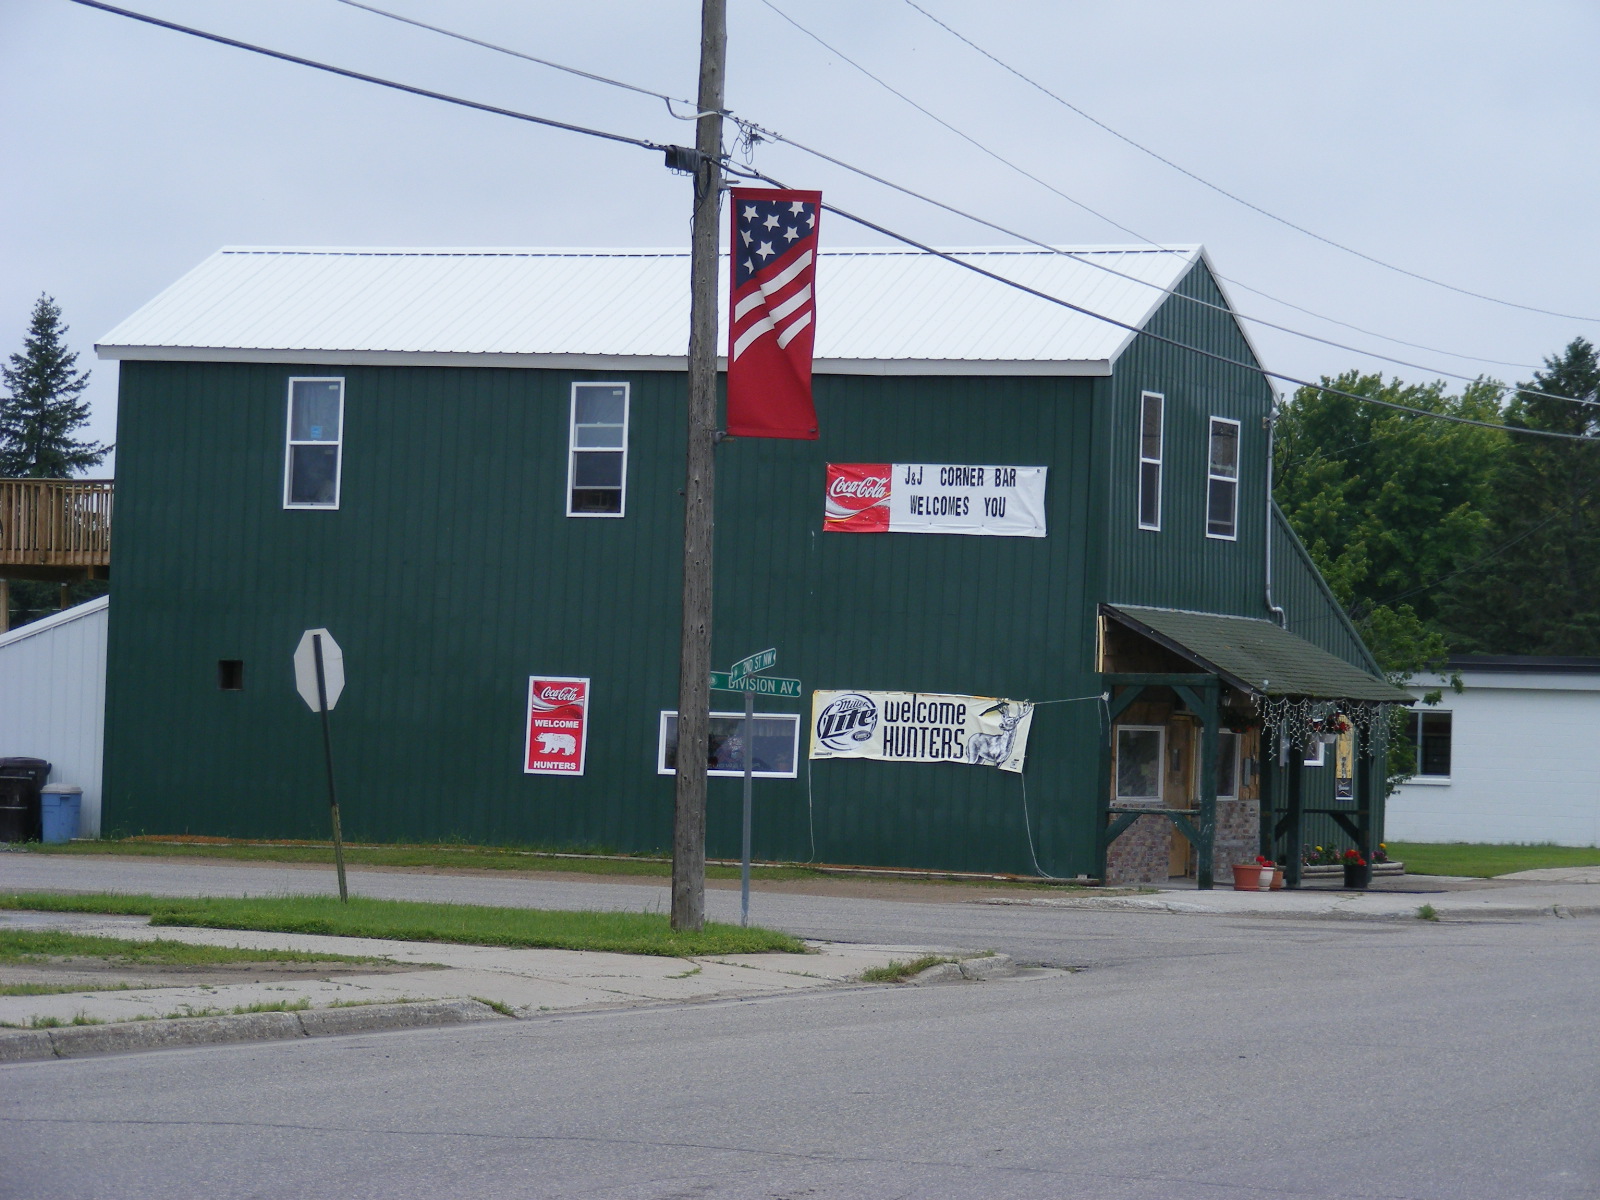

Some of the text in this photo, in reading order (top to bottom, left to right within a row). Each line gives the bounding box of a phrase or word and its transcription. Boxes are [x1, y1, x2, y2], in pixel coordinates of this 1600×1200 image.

[905, 465, 1017, 487] J&J CORNER BAR
[829, 476, 891, 498] Coca-Cola
[910, 495, 1007, 518] WELCOMES YOU
[755, 655, 762, 670] ST
[763, 651, 773, 667] NW
[540, 686, 579, 701] Coca-Cola
[728, 677, 794, 694] DIVISION AV
[835, 699, 870, 712] Miller
[884, 694, 966, 725] welcome
[535, 720, 579, 728] WELCOME
[820, 708, 877, 739] Lite
[533, 761, 577, 770] HUNTERS
